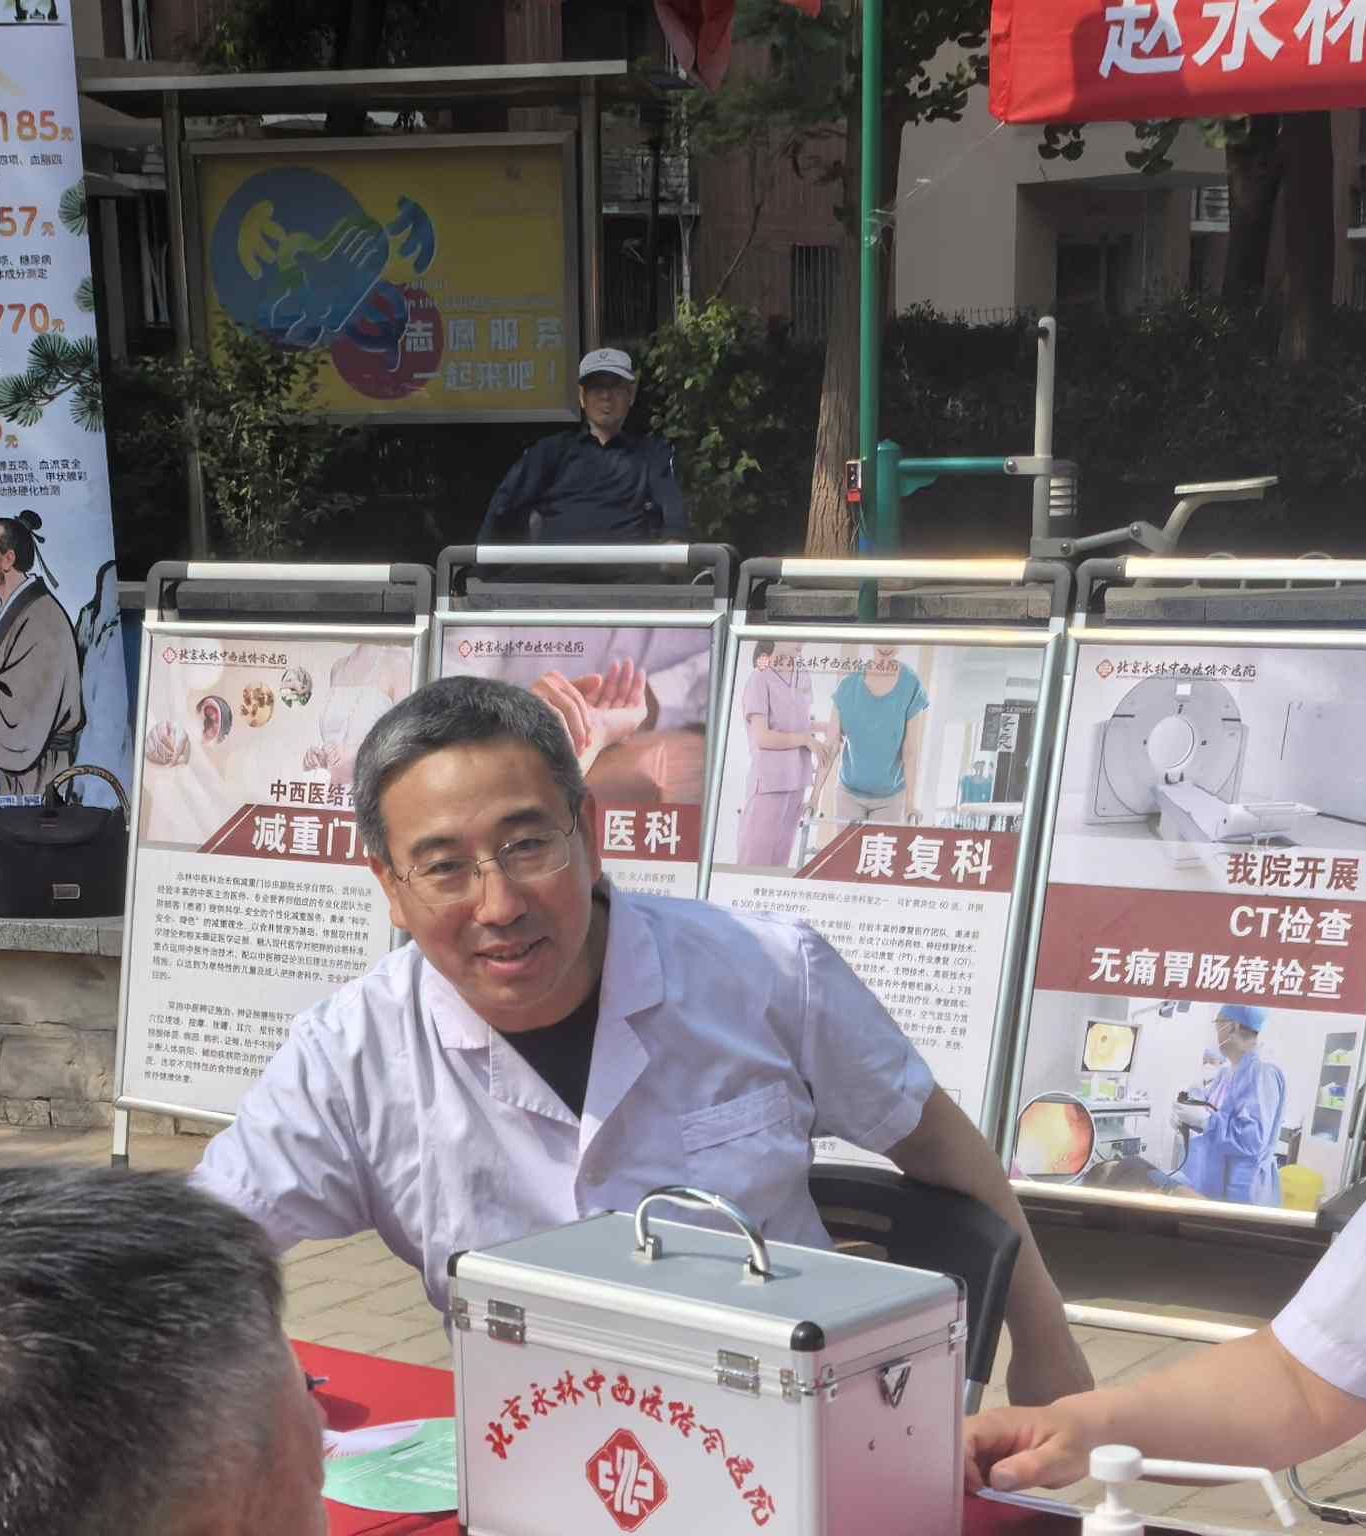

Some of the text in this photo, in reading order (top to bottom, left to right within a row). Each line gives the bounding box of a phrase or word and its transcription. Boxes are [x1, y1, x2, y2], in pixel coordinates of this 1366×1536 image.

[855, 831, 993, 885] 康复科
[1227, 852, 1360, 893] 我院开展
[1228, 903, 1353, 947] CT检查
[1089, 946, 1346, 999] 无痛胃肠镜检查
[484, 1369, 776, 1528] 北京永林中西医结合医院
